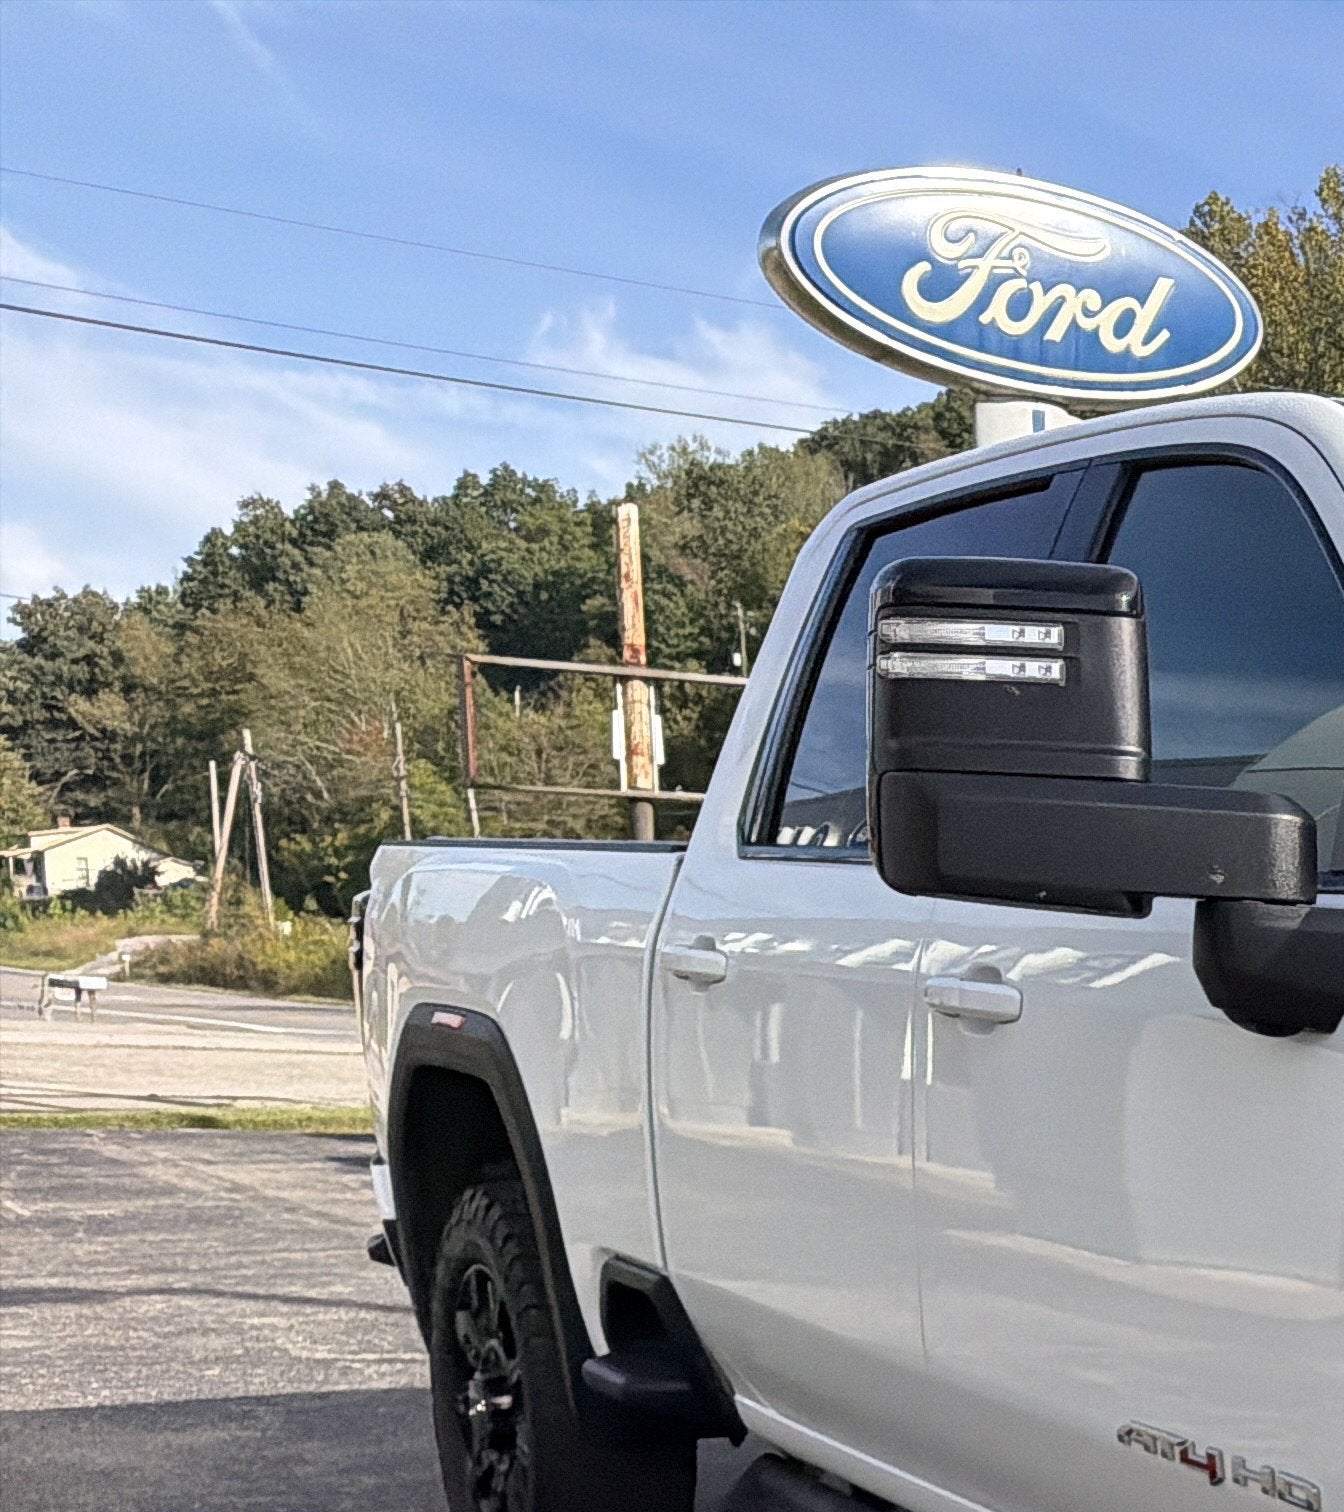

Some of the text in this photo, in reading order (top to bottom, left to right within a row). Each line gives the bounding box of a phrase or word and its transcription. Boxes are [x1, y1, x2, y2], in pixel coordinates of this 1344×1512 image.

[902, 208, 1175, 358] Ford
[1117, 1420, 1322, 1512] AT4 HD
